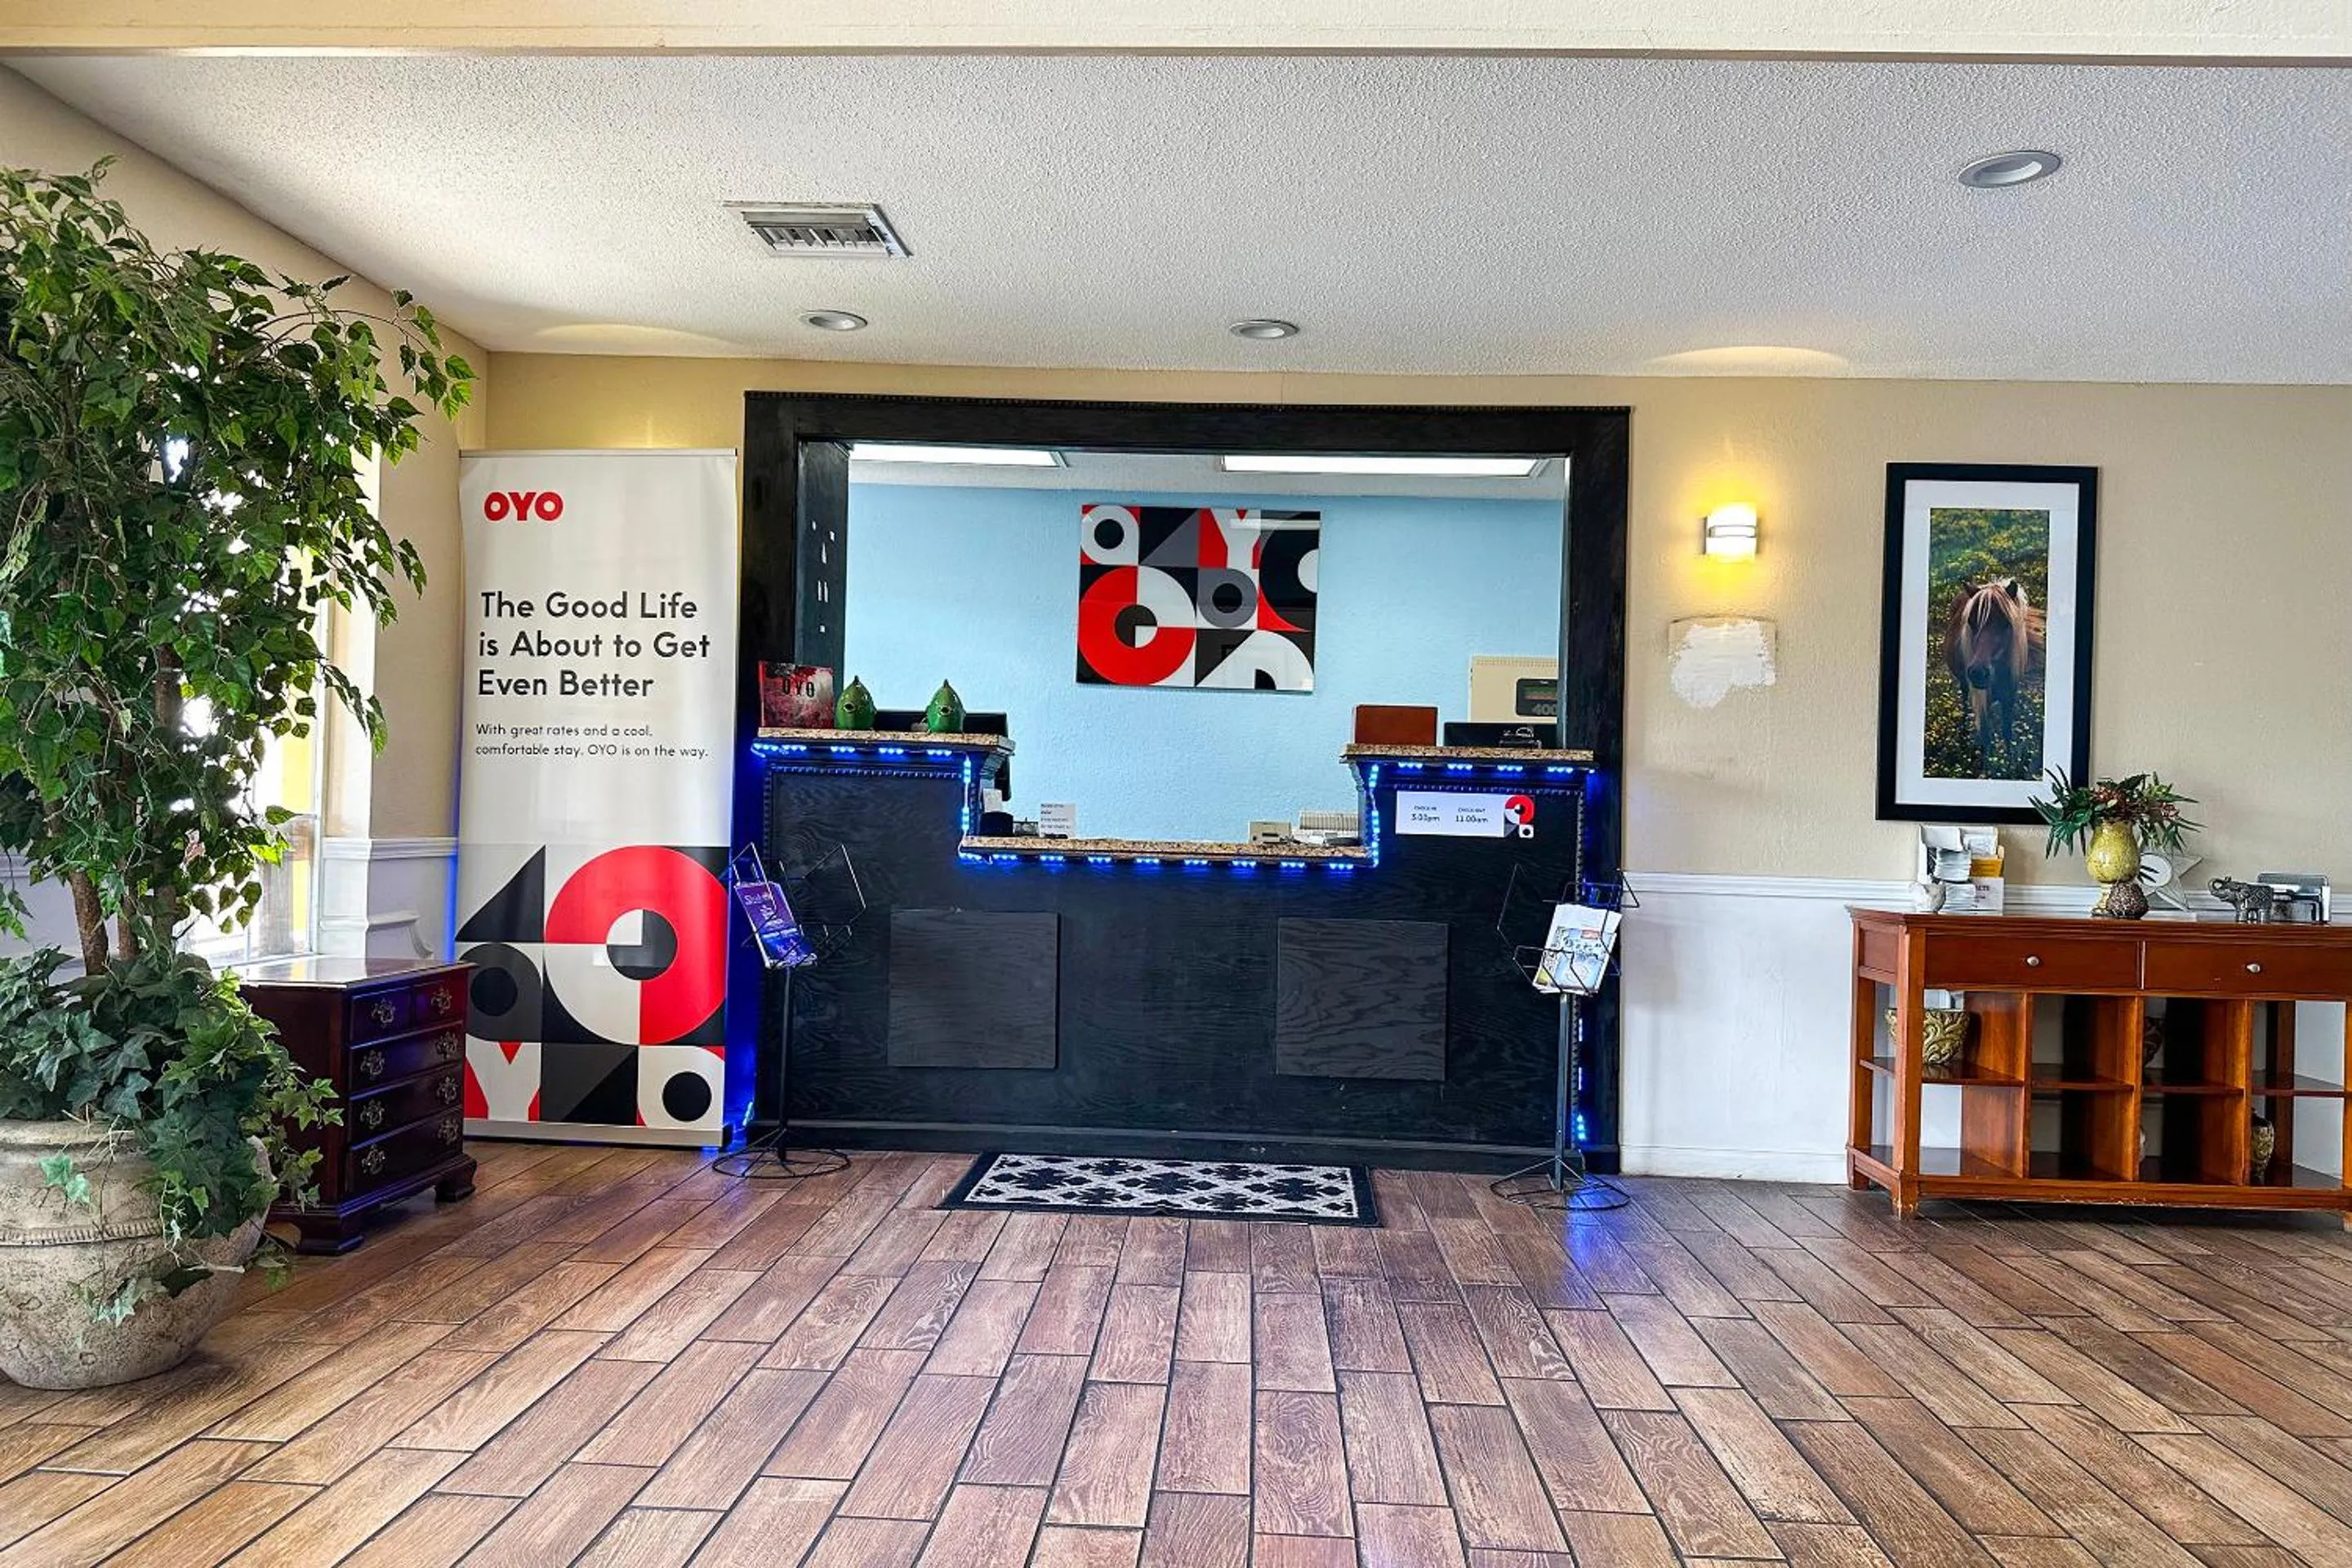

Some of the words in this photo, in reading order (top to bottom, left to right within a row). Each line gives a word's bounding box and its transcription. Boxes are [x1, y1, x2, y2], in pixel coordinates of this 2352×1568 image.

[483, 492, 564, 521] OYO
[481, 591, 534, 617] The
[546, 591, 627, 618] Good
[640, 591, 697, 618] Life
[479, 631, 499, 657] is
[510, 630, 603, 657] About
[613, 635, 642, 657] to
[653, 631, 710, 657] Get
[479, 670, 547, 695] Even
[560, 670, 654, 696] Better
[476, 724, 506, 735] With
[510, 725, 543, 738] great
[546, 725, 579, 736] rates
[584, 724, 608, 736] and
[475, 743, 550, 755] comfortable
[587, 744, 617, 755] OYO
[621, 745, 630, 755] is
[635, 747, 650, 756] on
[654, 744, 675, 756] the
[679, 748, 709, 760] way.
